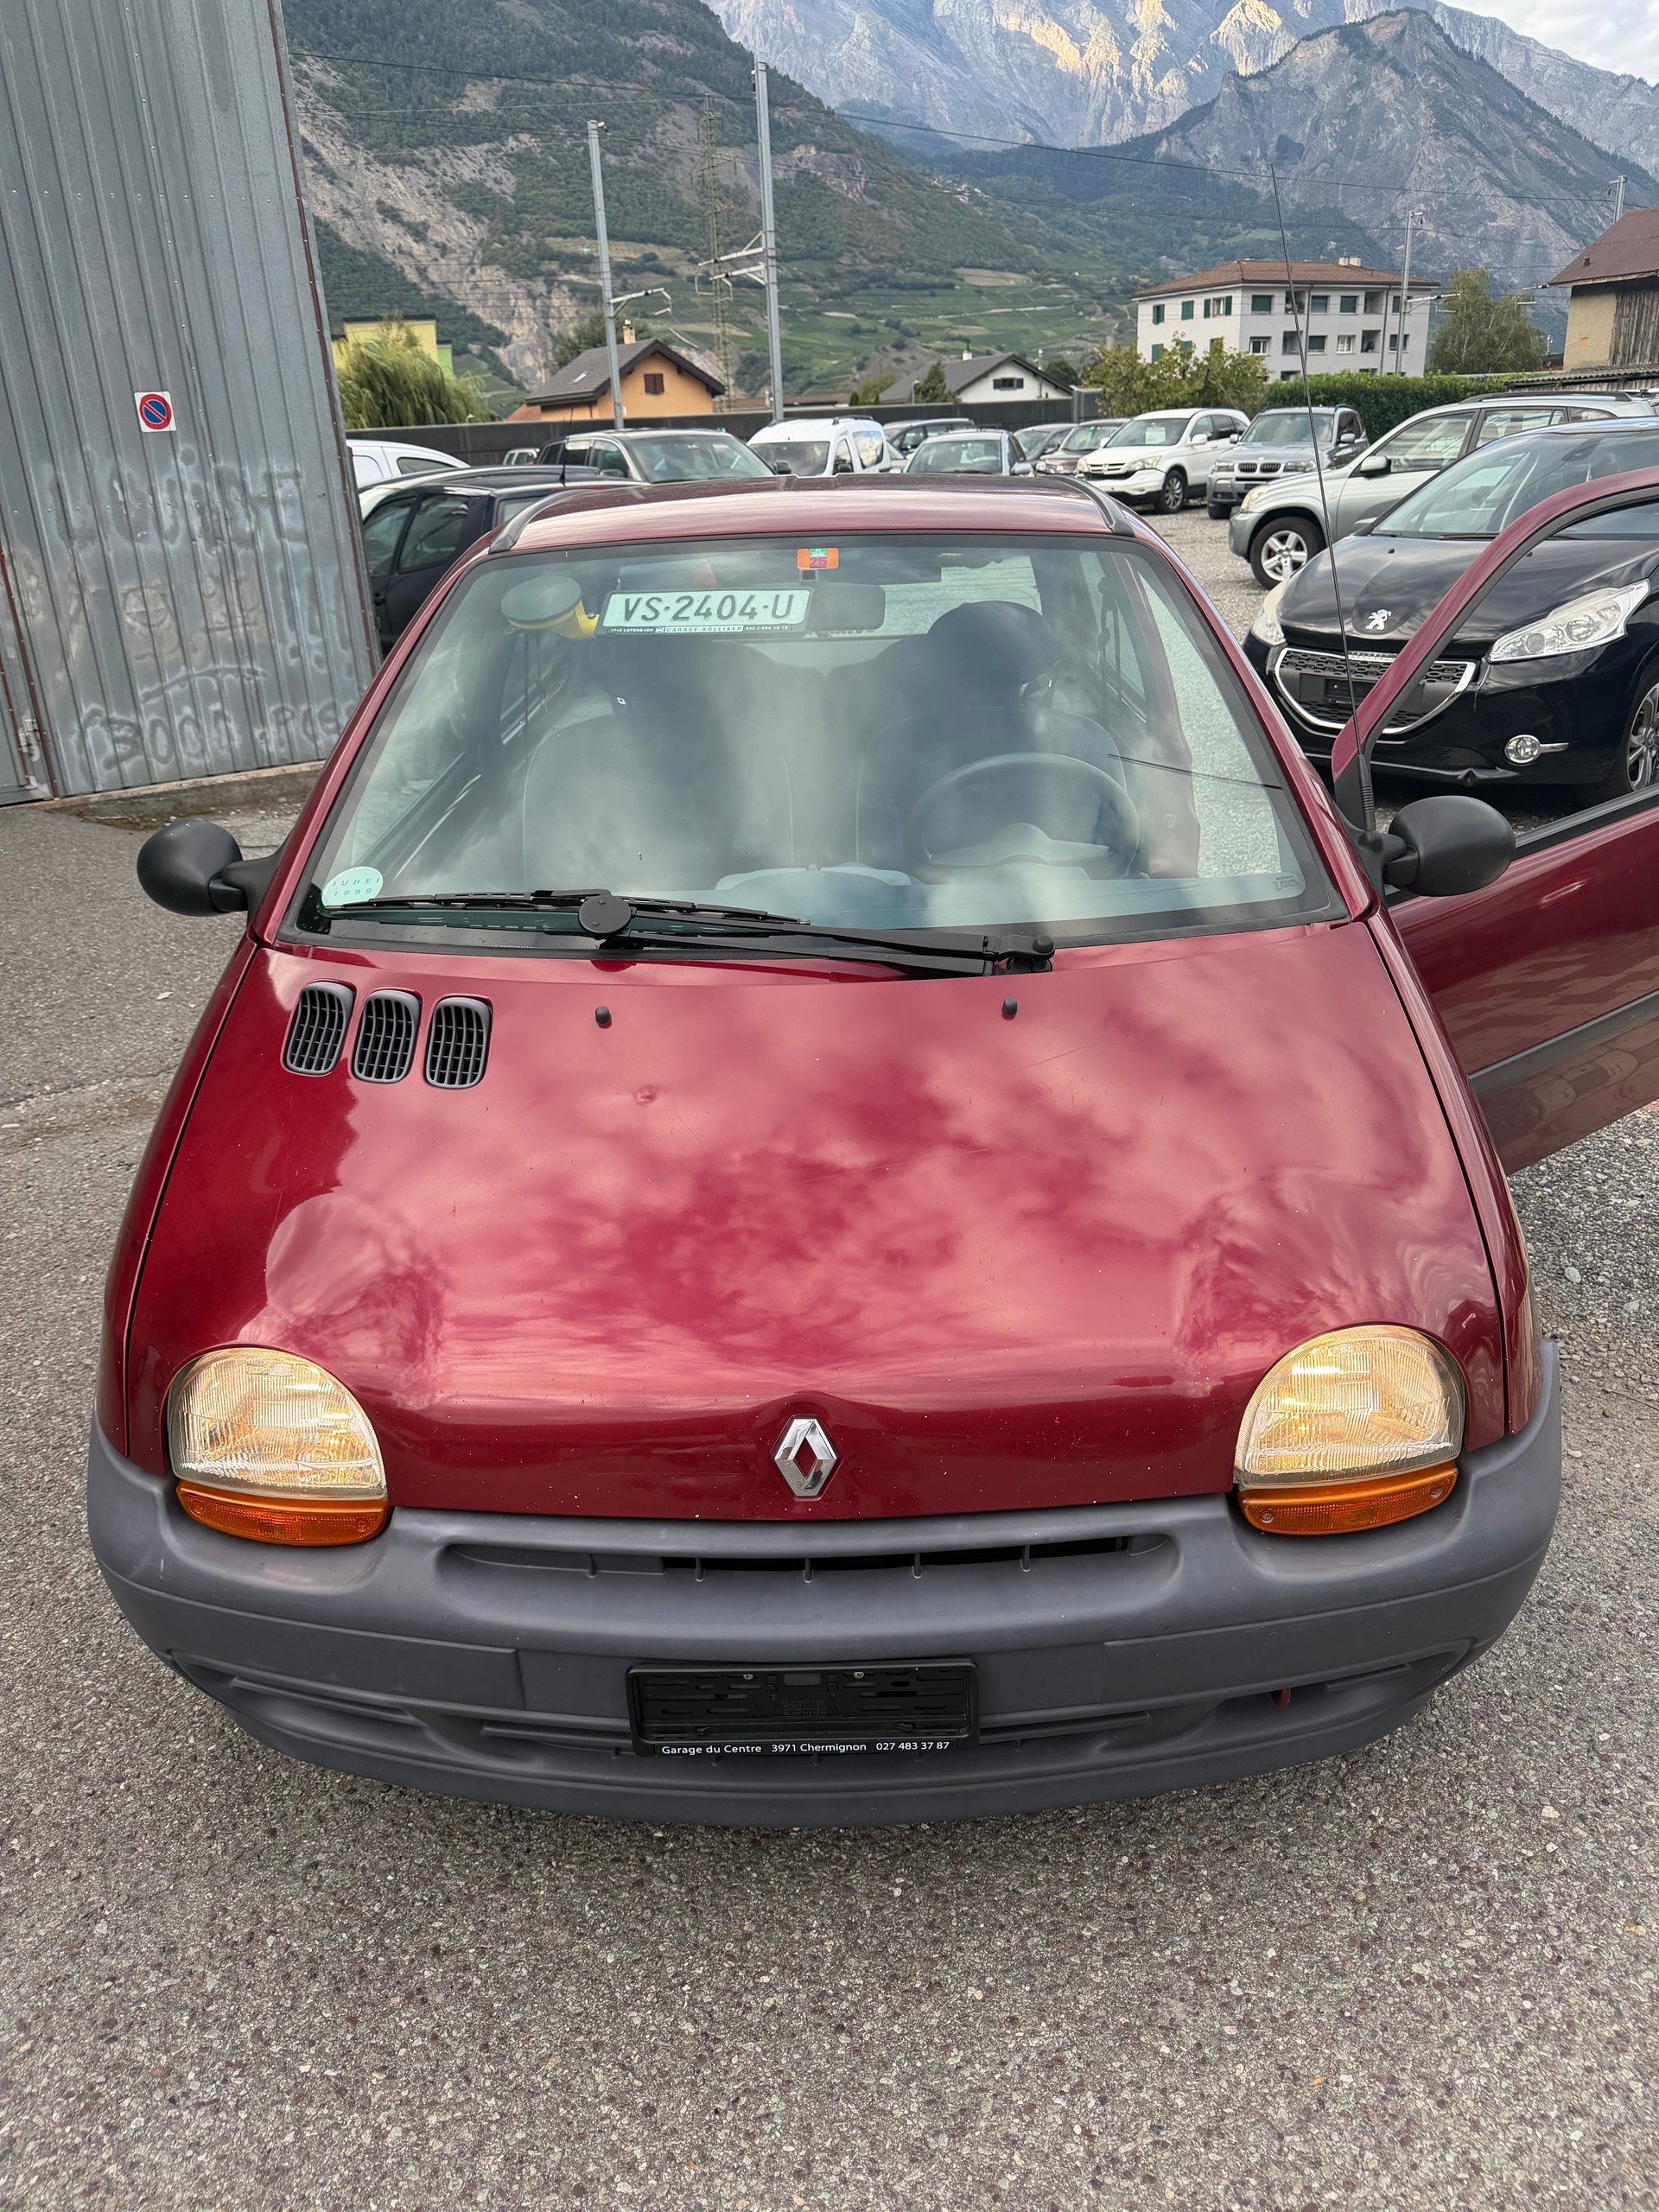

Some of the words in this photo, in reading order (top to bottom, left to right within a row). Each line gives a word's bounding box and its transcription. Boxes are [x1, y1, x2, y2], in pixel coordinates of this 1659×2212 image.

[334, 887, 372, 897] 1999
[662, 1745, 702, 1756] Garage
[724, 1745, 762, 1753] Centre
[772, 1744, 797, 1752] 3971
[800, 1743, 867, 1753] Chermignon
[876, 1742, 896, 1751] 027
[936, 1741, 950, 1750] 87
